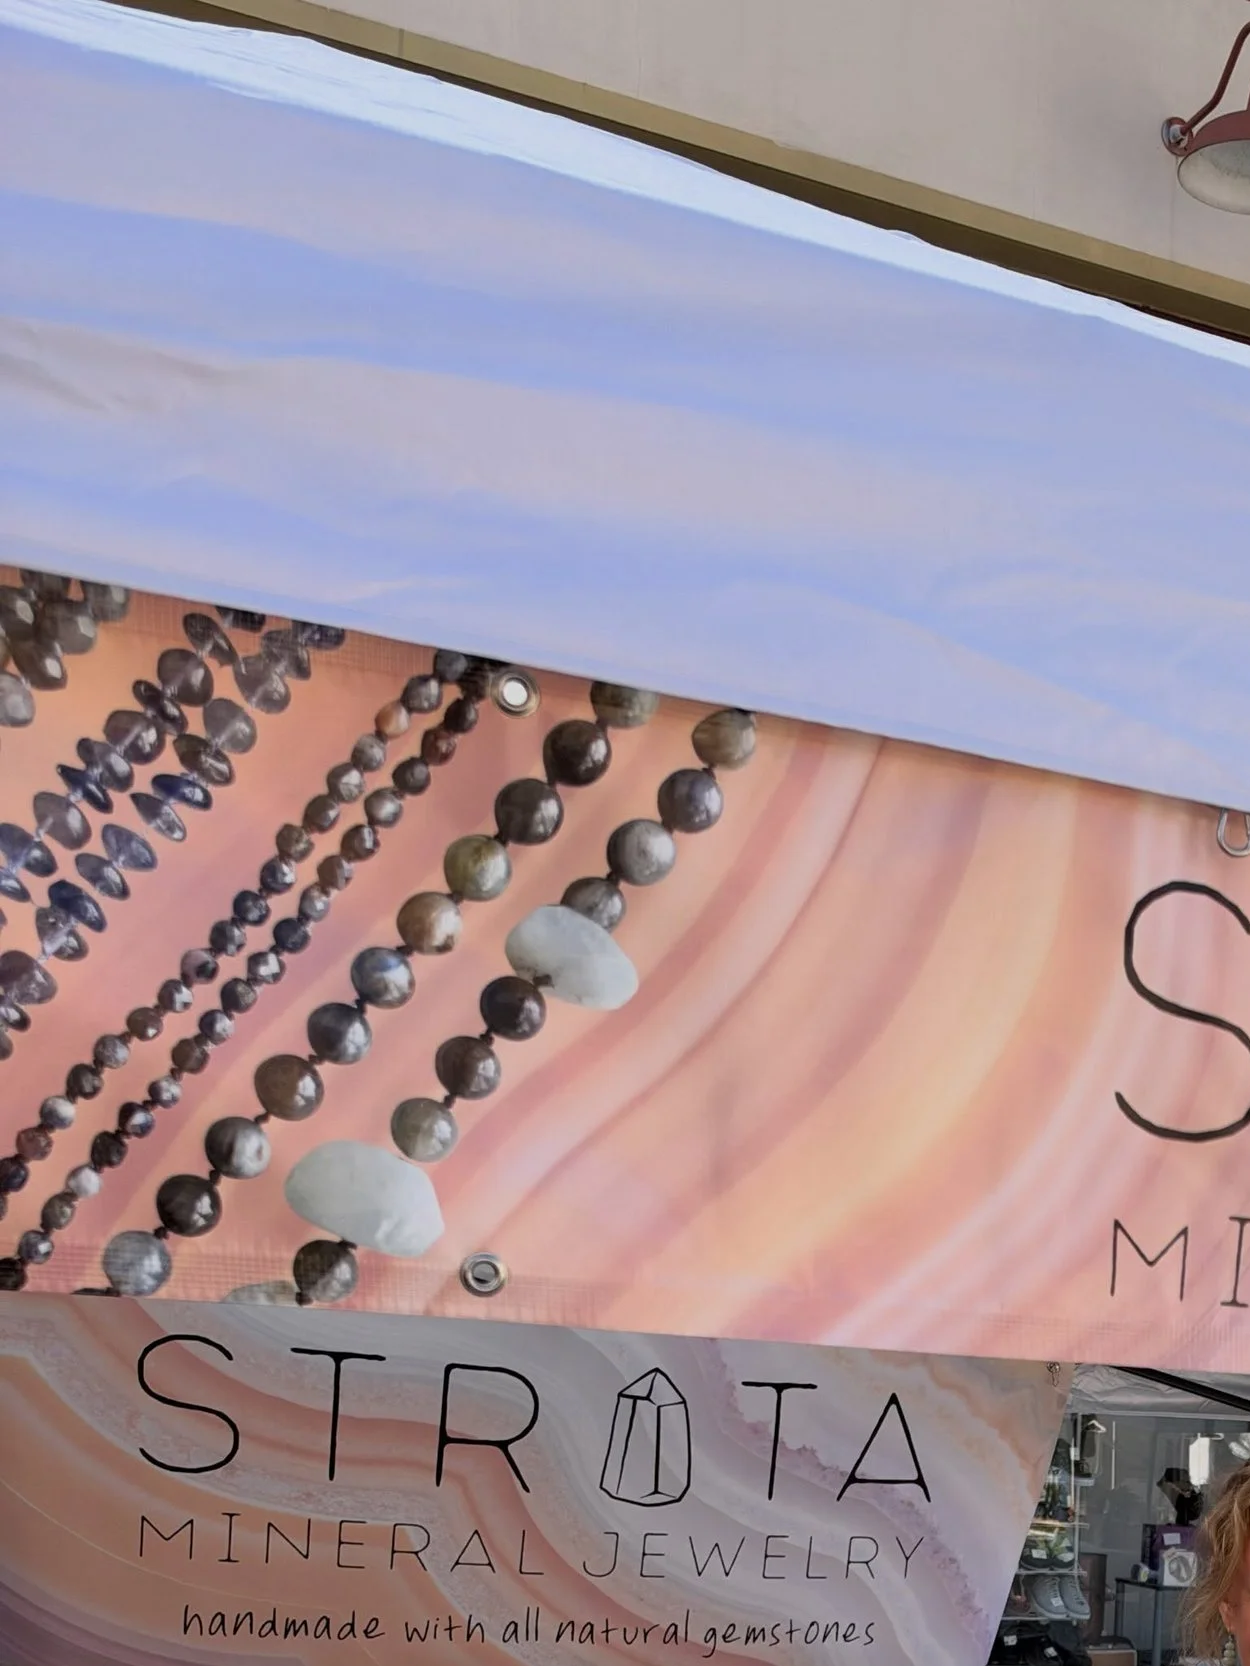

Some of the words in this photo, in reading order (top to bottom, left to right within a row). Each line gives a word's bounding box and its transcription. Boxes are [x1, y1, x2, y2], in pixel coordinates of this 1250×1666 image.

[138, 1511, 545, 1576] MINERAL
[582, 1531, 924, 1580] JEWELRY
[182, 1604, 386, 1643] handmade
[403, 1611, 486, 1644] with
[502, 1606, 541, 1644] all
[555, 1608, 689, 1647] natural
[702, 1617, 876, 1657] gemstones
